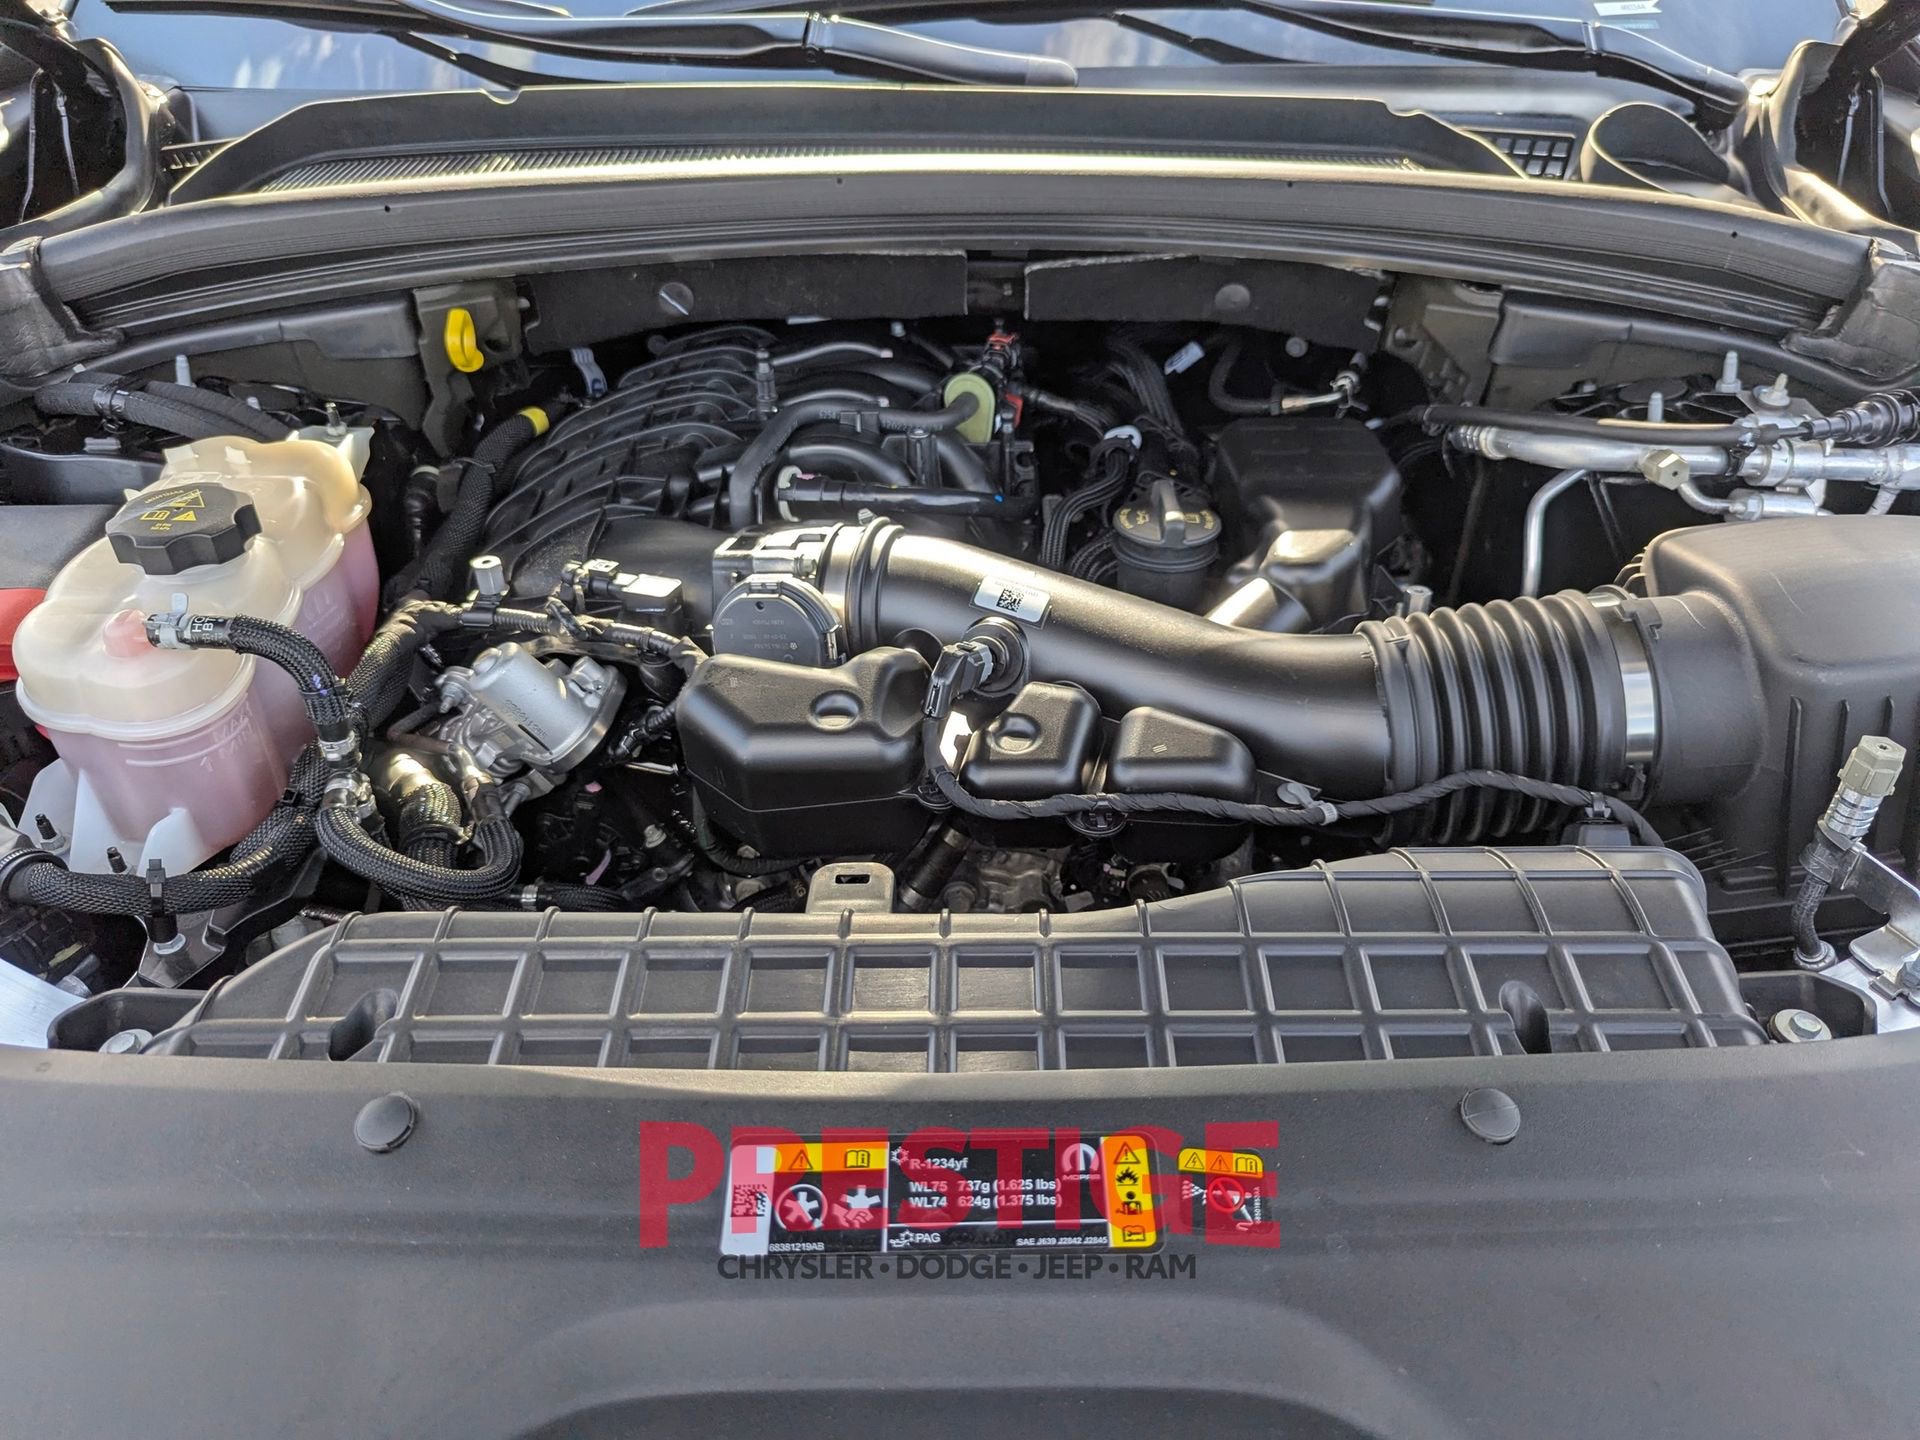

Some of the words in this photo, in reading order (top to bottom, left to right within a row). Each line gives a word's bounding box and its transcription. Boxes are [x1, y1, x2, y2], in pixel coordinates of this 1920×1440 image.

[909, 1157, 969, 1171] R-1234yf
[909, 1181, 948, 1193] WL75
[958, 1179, 990, 1193] 737g
[993, 1178, 1033, 1191] (1.625
[1035, 1178, 1061, 1191] lbs)
[909, 1196, 948, 1208] WL74
[958, 1195, 990, 1209] 624g
[993, 1194, 1034, 1208] (1.375
[1036, 1194, 1062, 1208] lbs)
[916, 1233, 941, 1243] PAG
[1016, 1237, 1035, 1246] SAE
